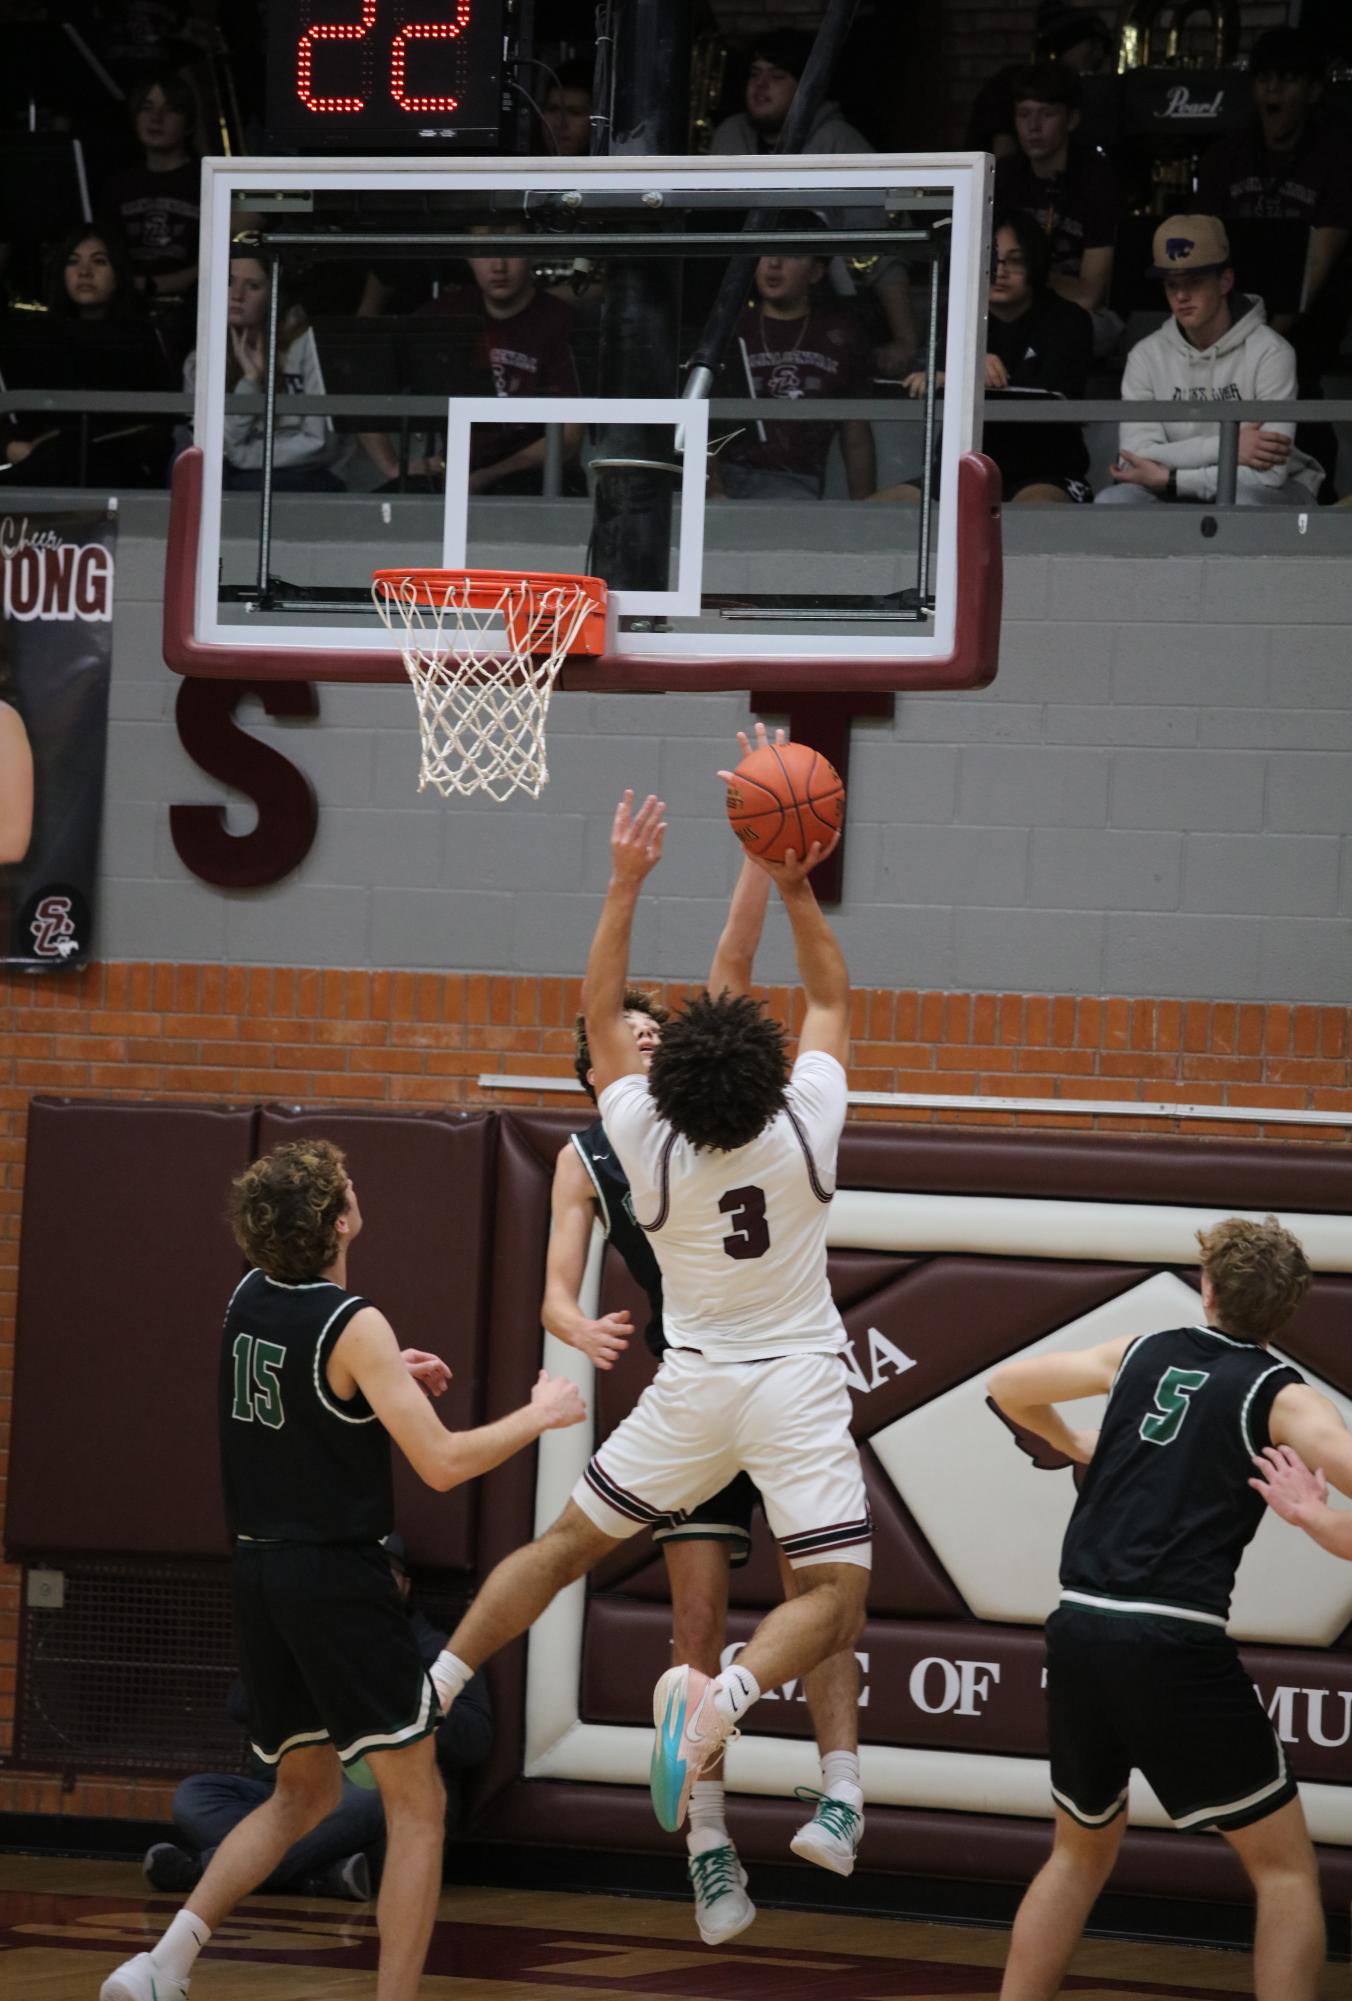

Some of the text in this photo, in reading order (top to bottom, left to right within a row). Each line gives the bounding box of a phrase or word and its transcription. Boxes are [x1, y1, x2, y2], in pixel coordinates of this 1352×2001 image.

[1153, 85, 1224, 117] Pearl
[0, 516, 62, 560] Cheer
[170, 676, 319, 887] S
[718, 1185, 771, 1259] 3
[232, 1333, 287, 1429] 15
[1139, 1366, 1209, 1446] 5
[909, 1657, 1000, 1716] OF
